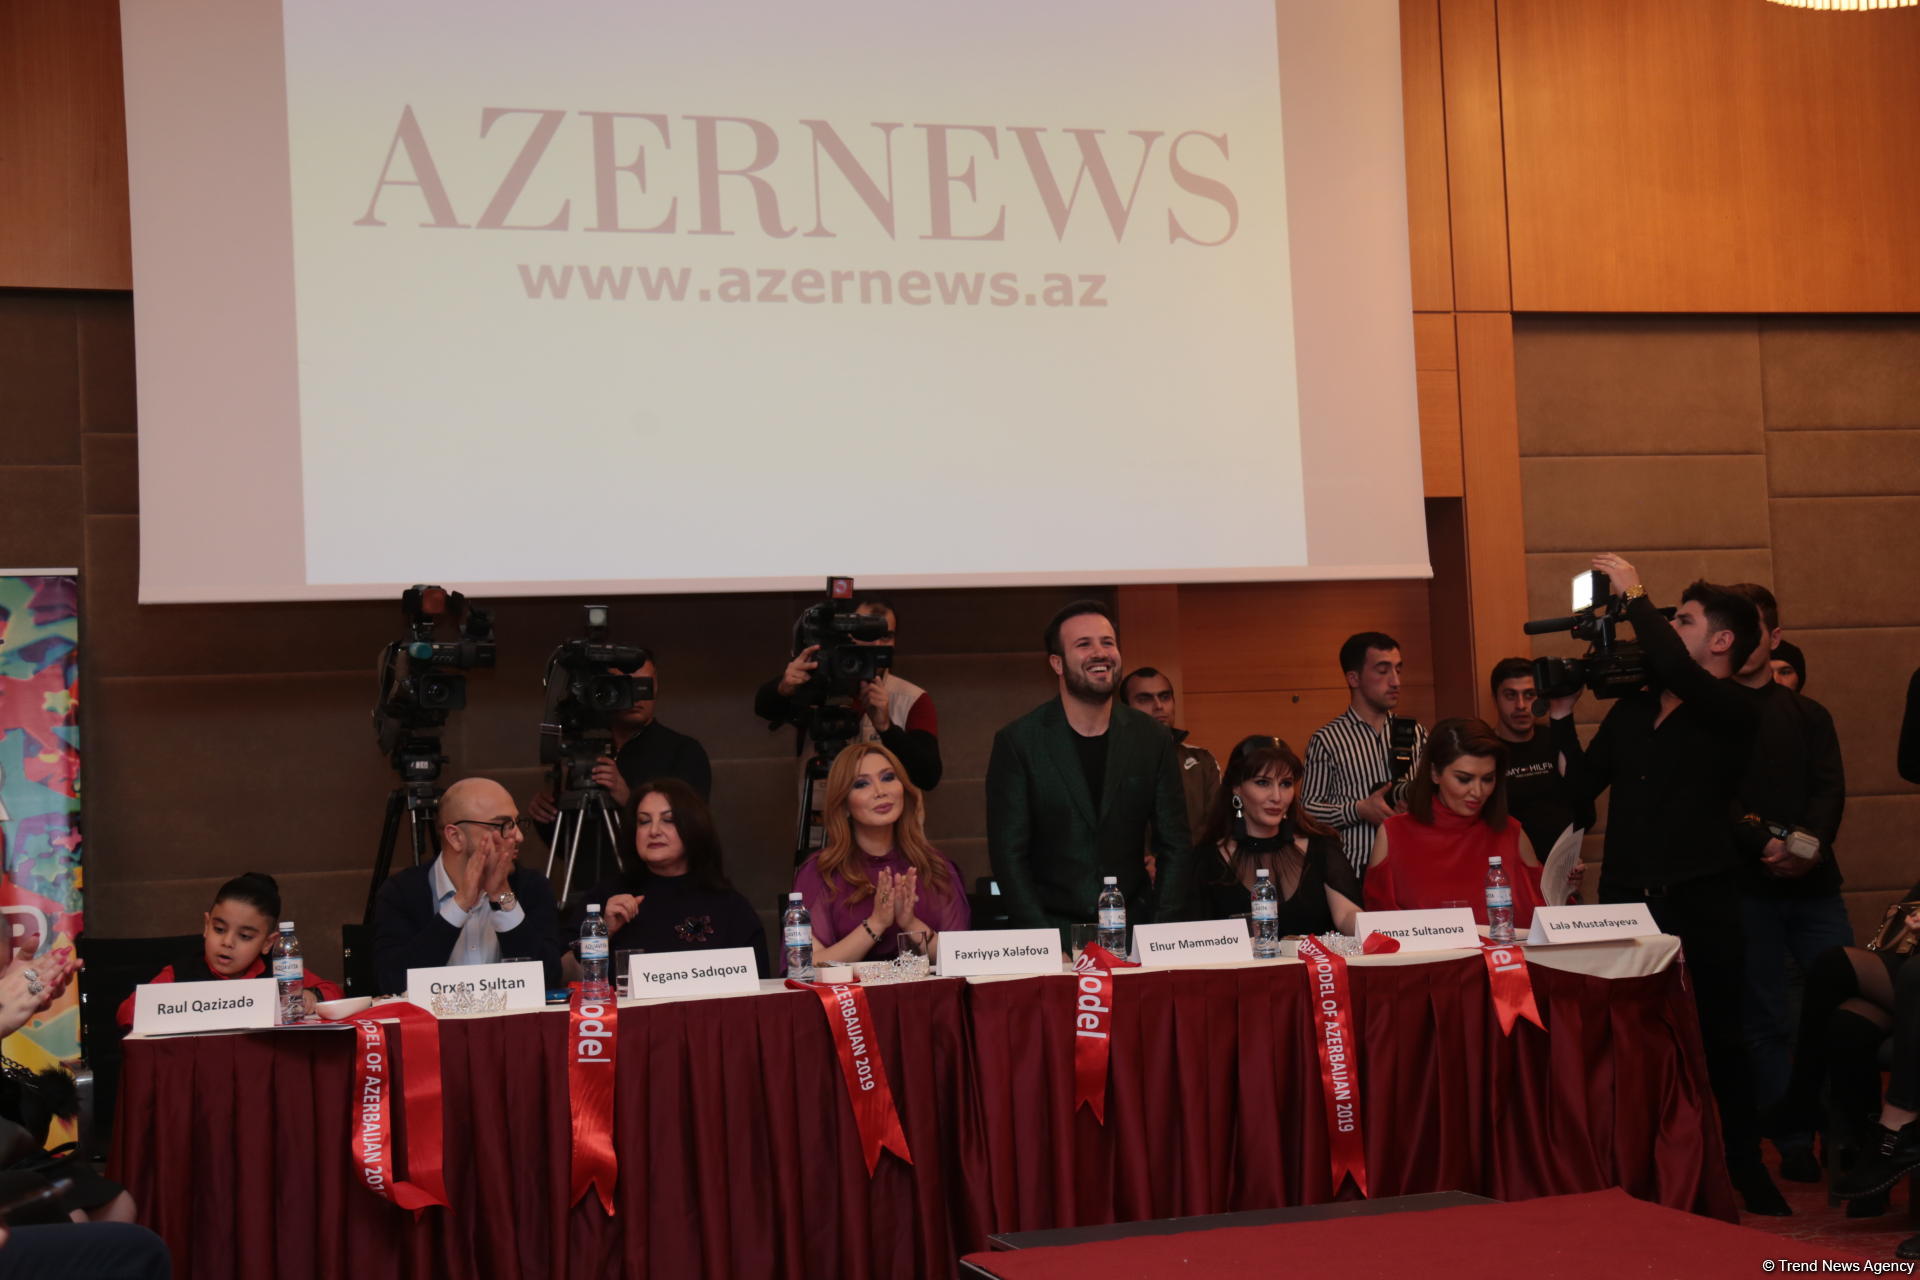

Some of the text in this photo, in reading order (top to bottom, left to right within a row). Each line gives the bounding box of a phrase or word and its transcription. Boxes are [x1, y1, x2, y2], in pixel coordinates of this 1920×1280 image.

[353, 104, 1239, 247] AZERNEWS
[516, 264, 1109, 307] www.azernews.az
[1412, 925, 1464, 936] Sultanova
[1572, 918, 1638, 930] Mustafayeva
[955, 948, 1000, 961] Fəxriyyə
[1149, 935, 1239, 952] Elnur Məmmədov
[479, 977, 526, 991] Sultan
[642, 970, 689, 984] Yeganə
[1312, 953, 1335, 998] MODEL
[157, 996, 255, 1015] Raul Qazizadə
[1321, 999, 1338, 1017] OF
[356, 1019, 381, 1050] ODEL
[578, 1000, 613, 1063] odel
[831, 985, 875, 1091] ZERBAIJAN 2019
[366, 1052, 382, 1072] OF
[1324, 1021, 1352, 1101] AZERBAIJAN
[362, 1075, 383, 1164] AZERBAIJAN
[1336, 1102, 1355, 1133] 2019
